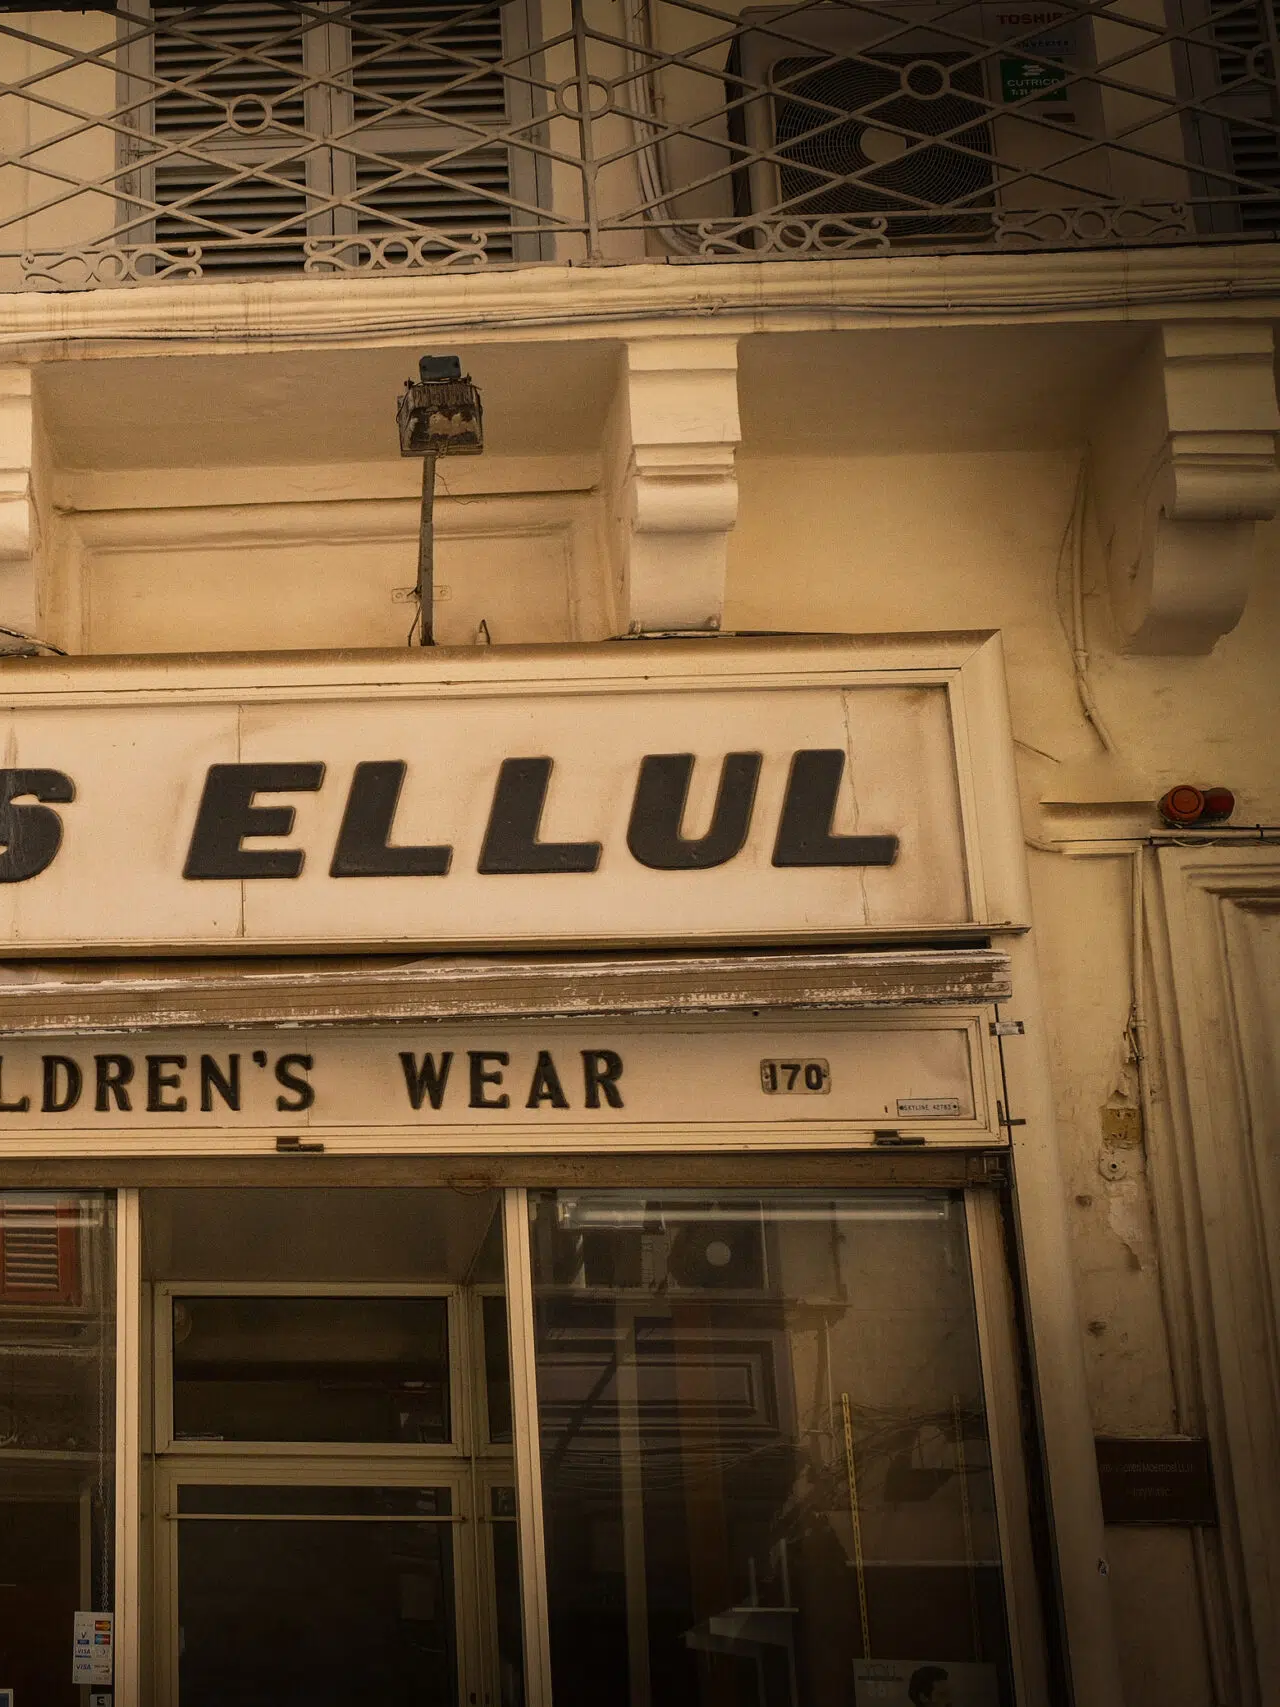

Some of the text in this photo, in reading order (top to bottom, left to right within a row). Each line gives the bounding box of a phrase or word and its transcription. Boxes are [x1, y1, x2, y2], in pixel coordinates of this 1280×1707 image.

[182, 748, 899, 880] ELLUL
[398, 1048, 626, 1110] WEAR
[768, 1063, 825, 1091] 170
